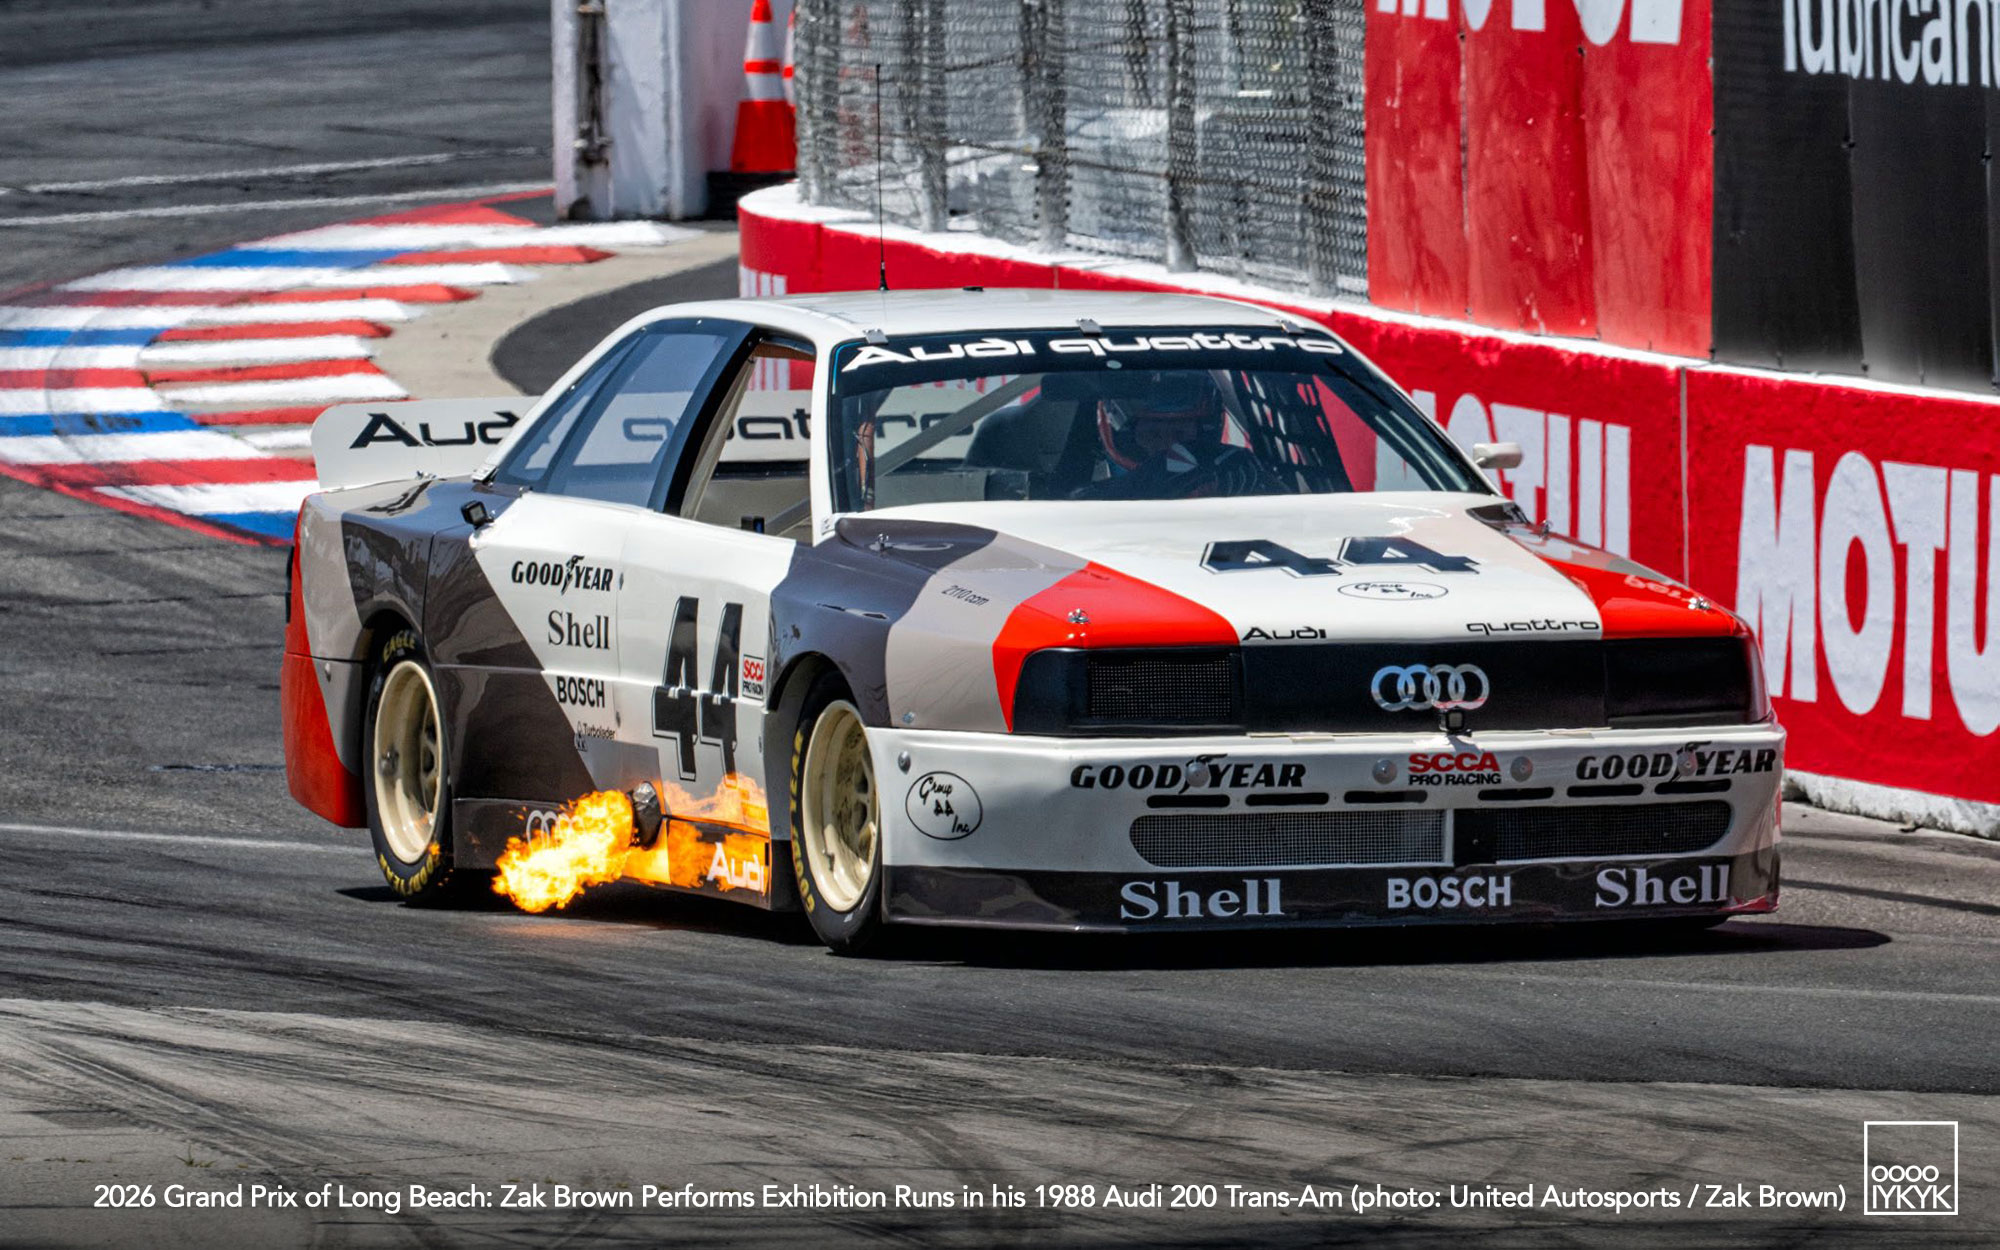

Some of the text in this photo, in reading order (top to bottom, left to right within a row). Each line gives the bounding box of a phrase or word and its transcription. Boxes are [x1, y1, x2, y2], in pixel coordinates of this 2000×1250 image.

[842, 335, 1344, 372] Audi quattro
[1200, 536, 1481, 579] 44
[512, 556, 613, 595] GOODYEAR
[548, 610, 609, 650] Shell
[1242, 627, 1327, 641] Audi
[1466, 619, 1600, 636] quattro
[556, 676, 605, 708] BOSCH
[652, 595, 743, 789] 44
[1070, 763, 1306, 789] GOODYEAR
[1408, 752, 1500, 772] SCCA
[1575, 748, 1777, 780] GOODYEAR
[1408, 773, 1502, 786] PRO RACING
[706, 841, 765, 893] Audi
[1120, 878, 1285, 919] Shell
[1388, 877, 1511, 908] BOSCH
[1595, 863, 1731, 907] Shell
